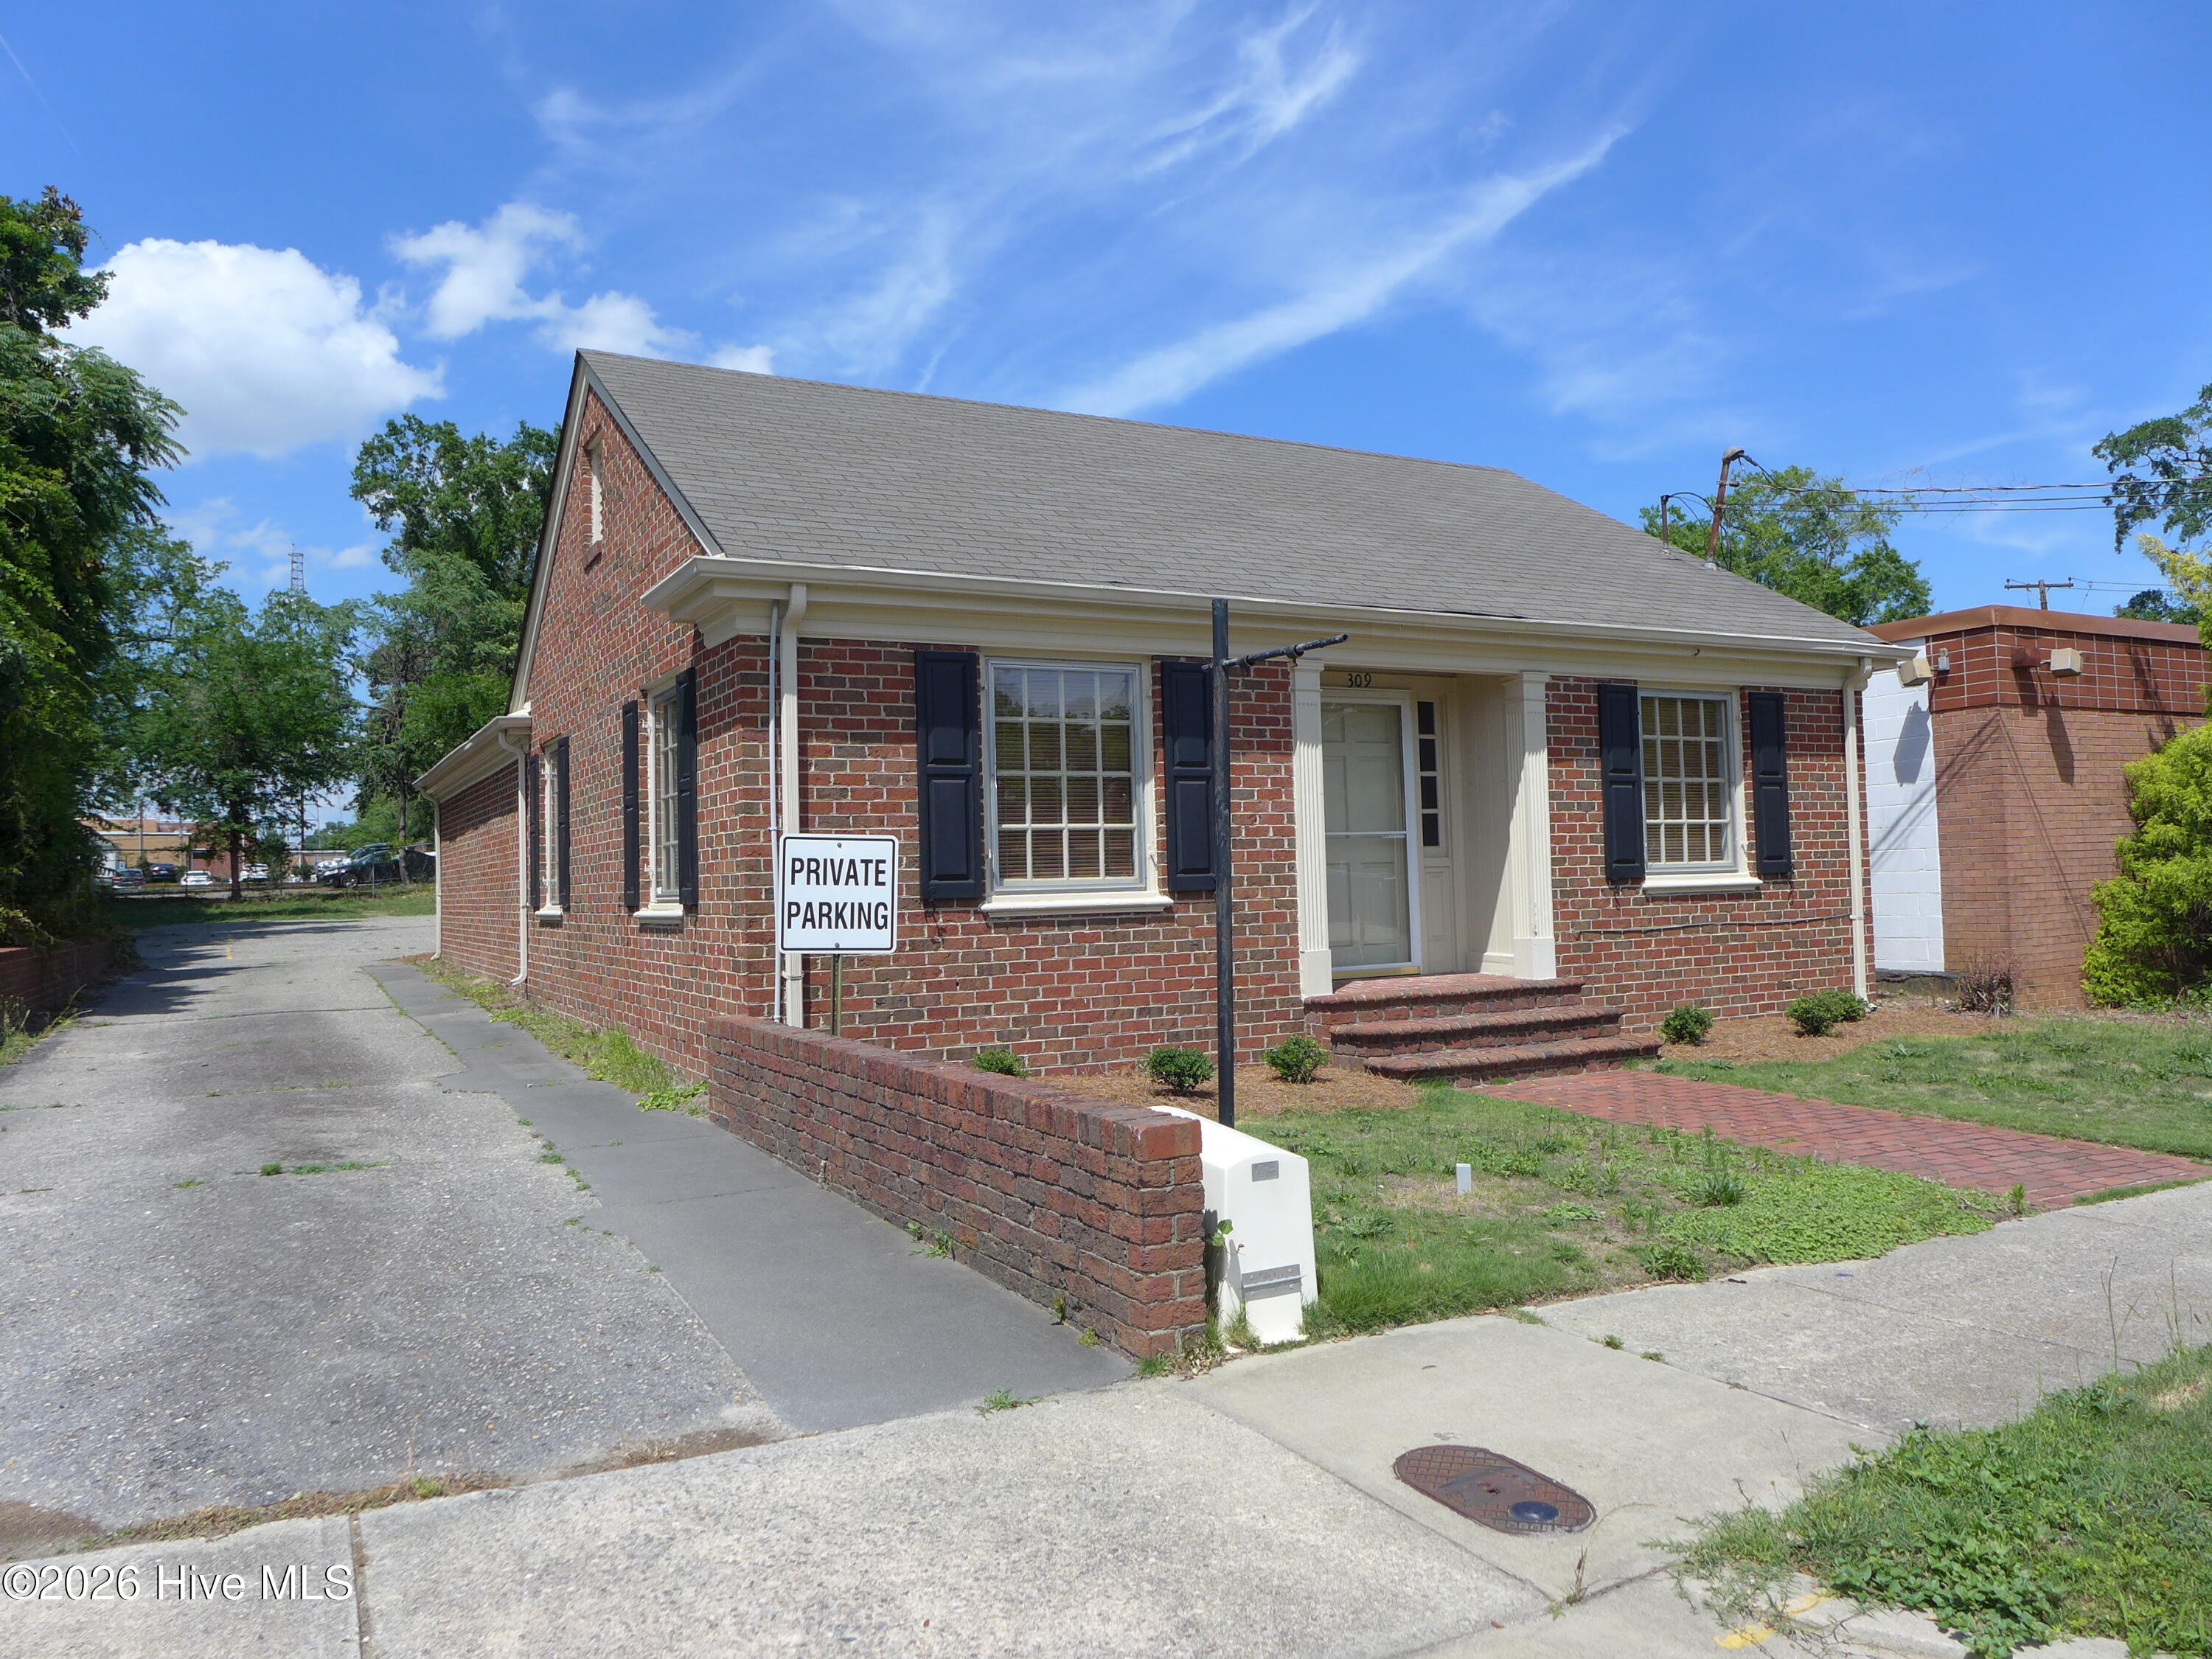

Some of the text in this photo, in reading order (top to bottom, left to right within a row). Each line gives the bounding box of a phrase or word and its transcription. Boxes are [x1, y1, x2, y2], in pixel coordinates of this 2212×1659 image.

[1347, 672, 1371, 688] 309
[790, 858, 886, 886] PRIVATE
[787, 901, 888, 930] PARKING
